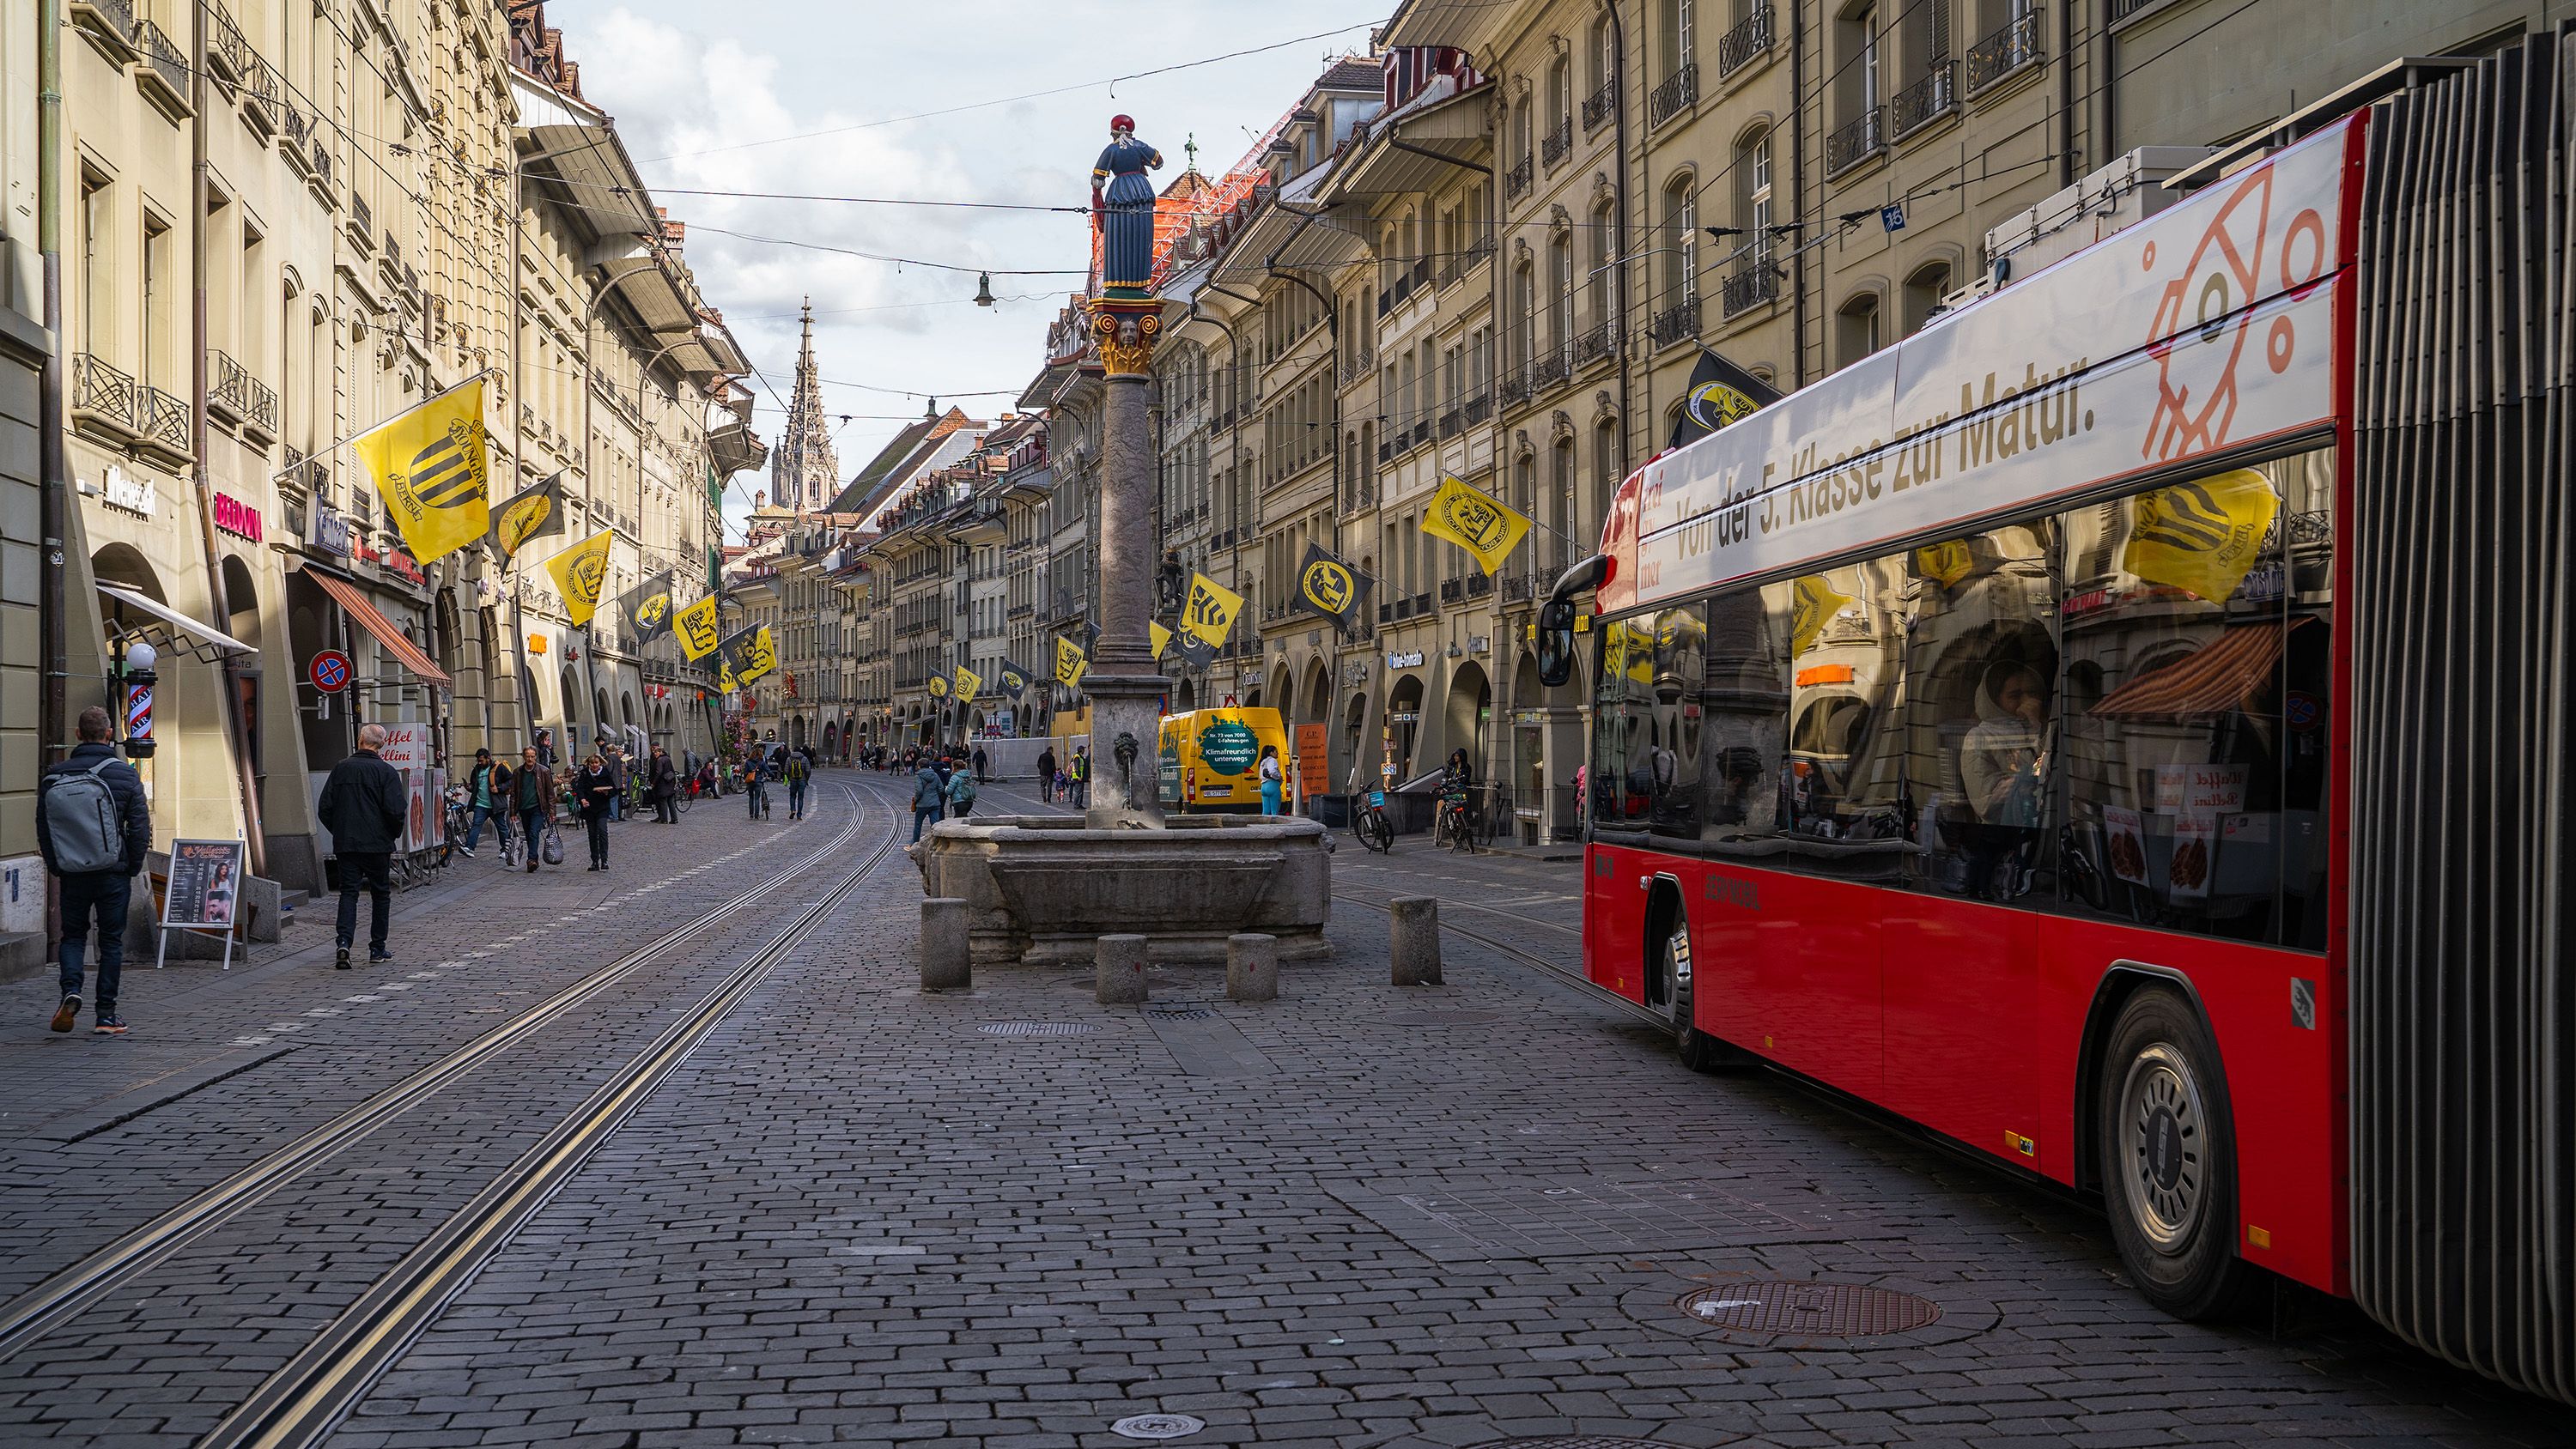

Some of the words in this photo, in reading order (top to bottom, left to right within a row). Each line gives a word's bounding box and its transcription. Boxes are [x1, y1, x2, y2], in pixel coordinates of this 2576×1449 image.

[1677, 495, 1713, 561] Von
[1717, 475, 1755, 549] der
[1760, 462, 1781, 535] 5.
[1789, 438, 1882, 525] Klasse
[1893, 408, 1952, 493] zur
[1959, 357, 2095, 471] Matur.
[396, 480, 417, 514] BERN
[1642, 469, 1664, 513] frei
[216, 491, 263, 543] BELDONA
[502, 500, 528, 524] BERNER
[1640, 559, 1662, 591] mer
[1705, 873, 1760, 911] BERNMOBIL
[2156, 1113, 2169, 1184] HESS
